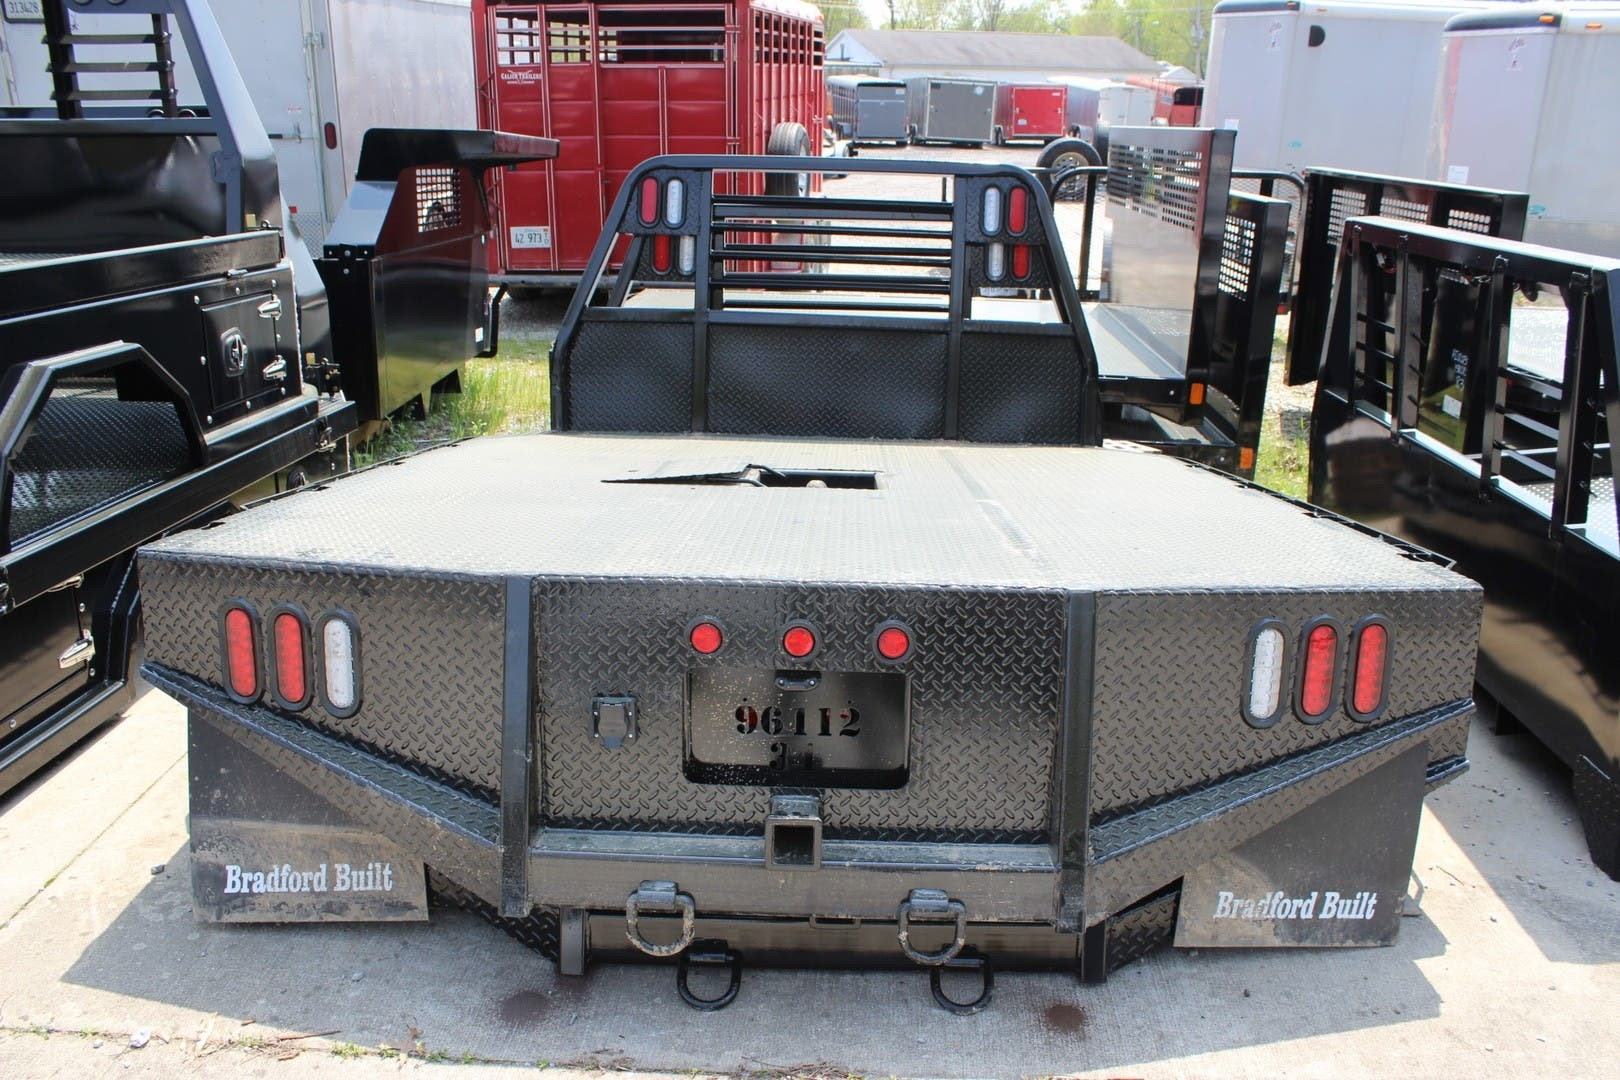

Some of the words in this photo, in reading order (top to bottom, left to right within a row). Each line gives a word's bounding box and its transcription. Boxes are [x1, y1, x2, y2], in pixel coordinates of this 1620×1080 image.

[735, 705, 861, 737] 96112
[224, 864, 328, 894] Bradford
[333, 862, 393, 892] Built
[1213, 891, 1318, 919] Bradford
[1319, 892, 1377, 919] Built
